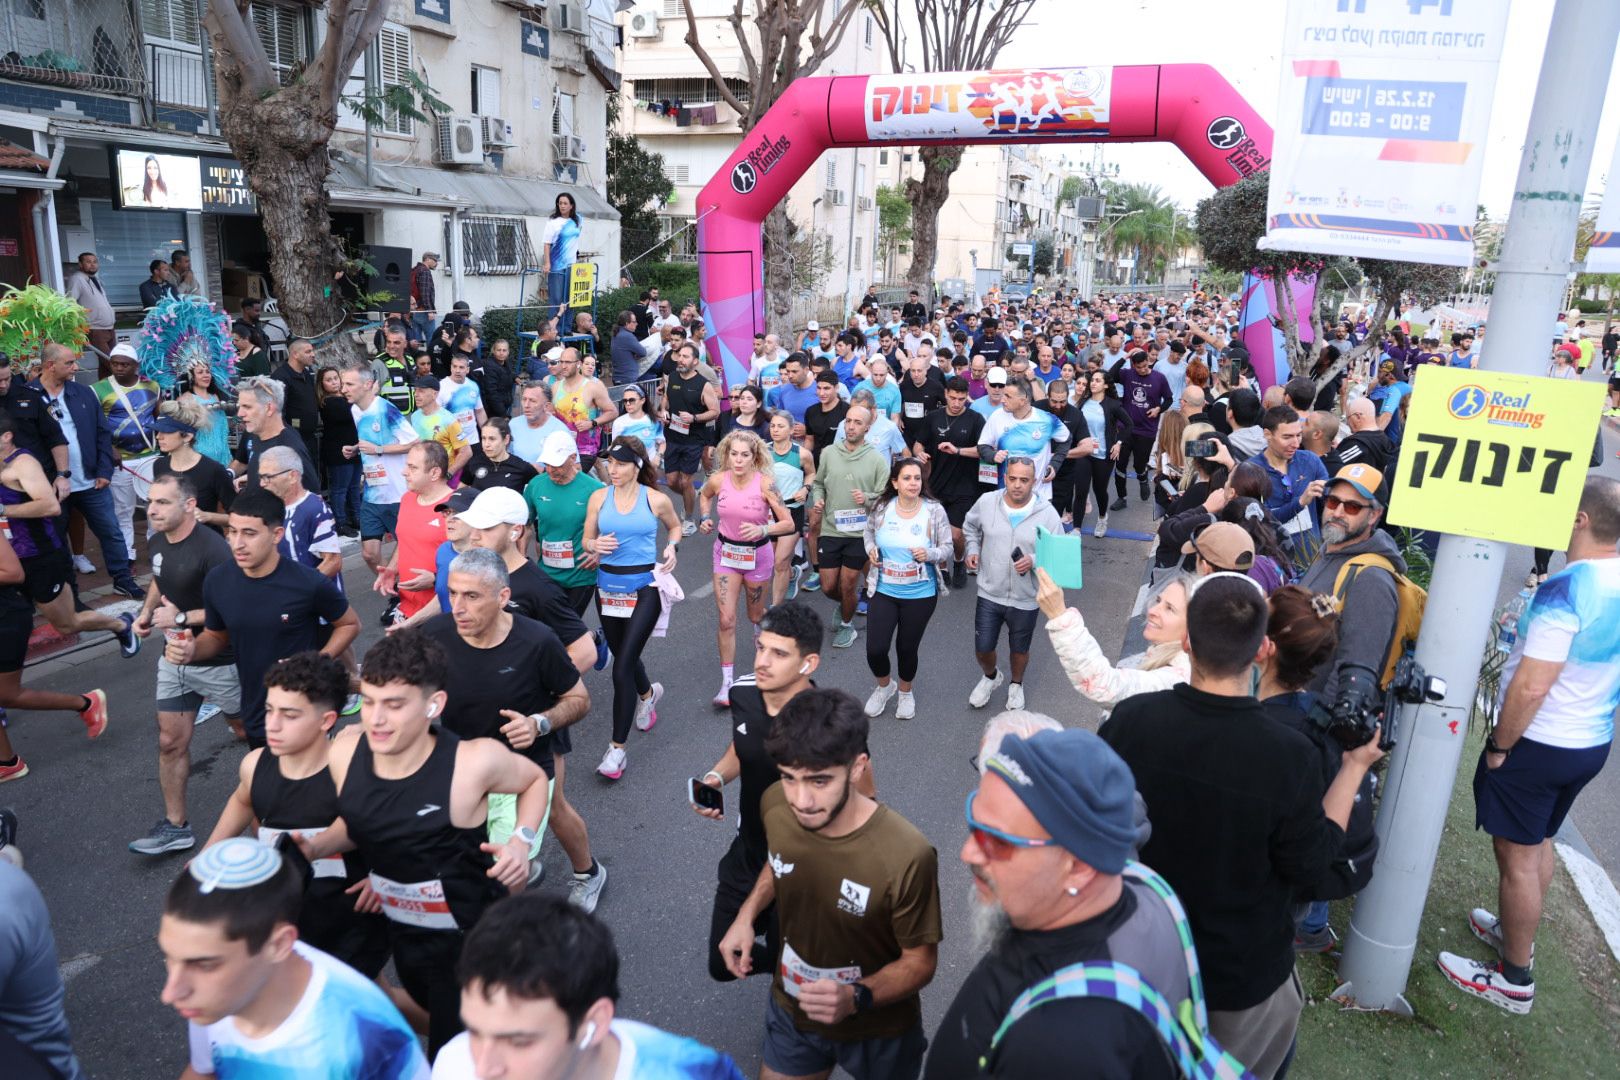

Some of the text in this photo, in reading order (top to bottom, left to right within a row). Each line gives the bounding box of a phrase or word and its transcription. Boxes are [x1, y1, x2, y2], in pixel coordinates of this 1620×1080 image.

[872, 84, 962, 122] זינוק
[748, 134, 773, 163] Real
[753, 135, 791, 174] Timing
[1490, 391, 1531, 409] Real
[1487, 405, 1545, 429] Timing
[1409, 433, 1573, 494] זינוק
